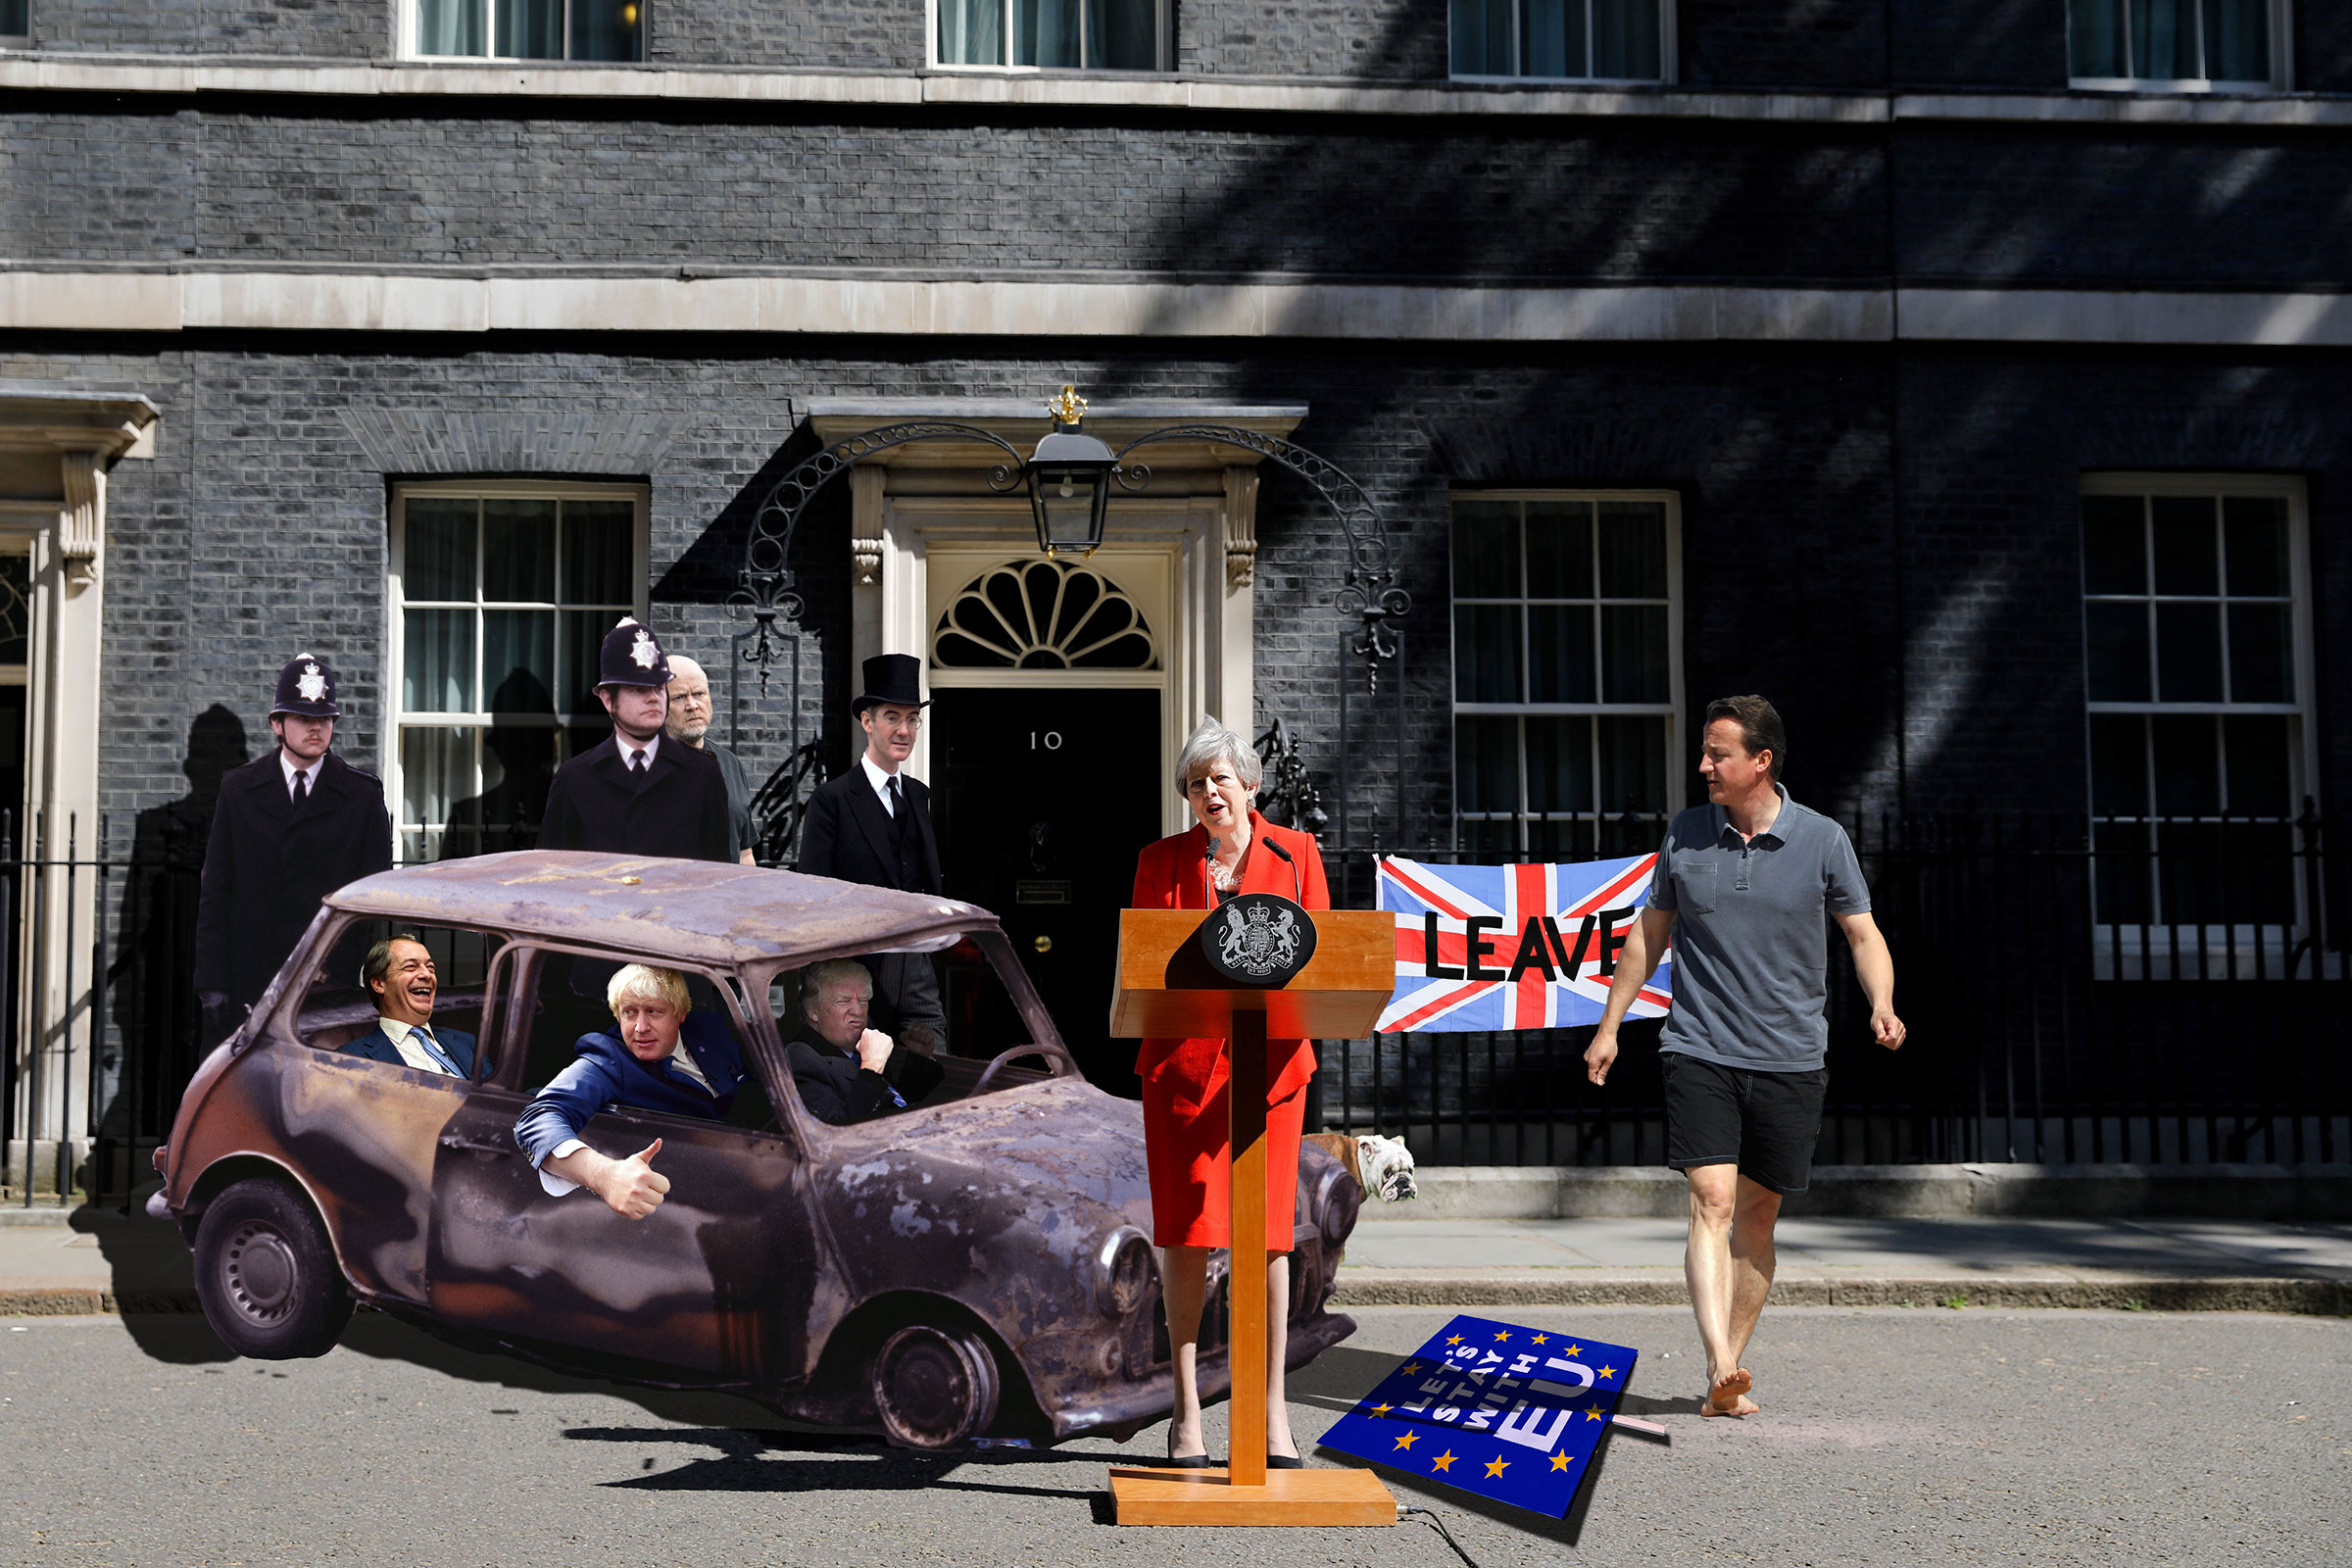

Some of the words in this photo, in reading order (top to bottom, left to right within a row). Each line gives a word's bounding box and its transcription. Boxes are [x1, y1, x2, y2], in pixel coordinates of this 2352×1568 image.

[1030, 731, 1062, 750] 10
[1425, 905, 1636, 982] LEAVE
[1400, 1345, 1479, 1413] LET'S
[1432, 1348, 1505, 1422] STAY
[1460, 1353, 1539, 1430] WITH
[1493, 1357, 1595, 1453] EU
